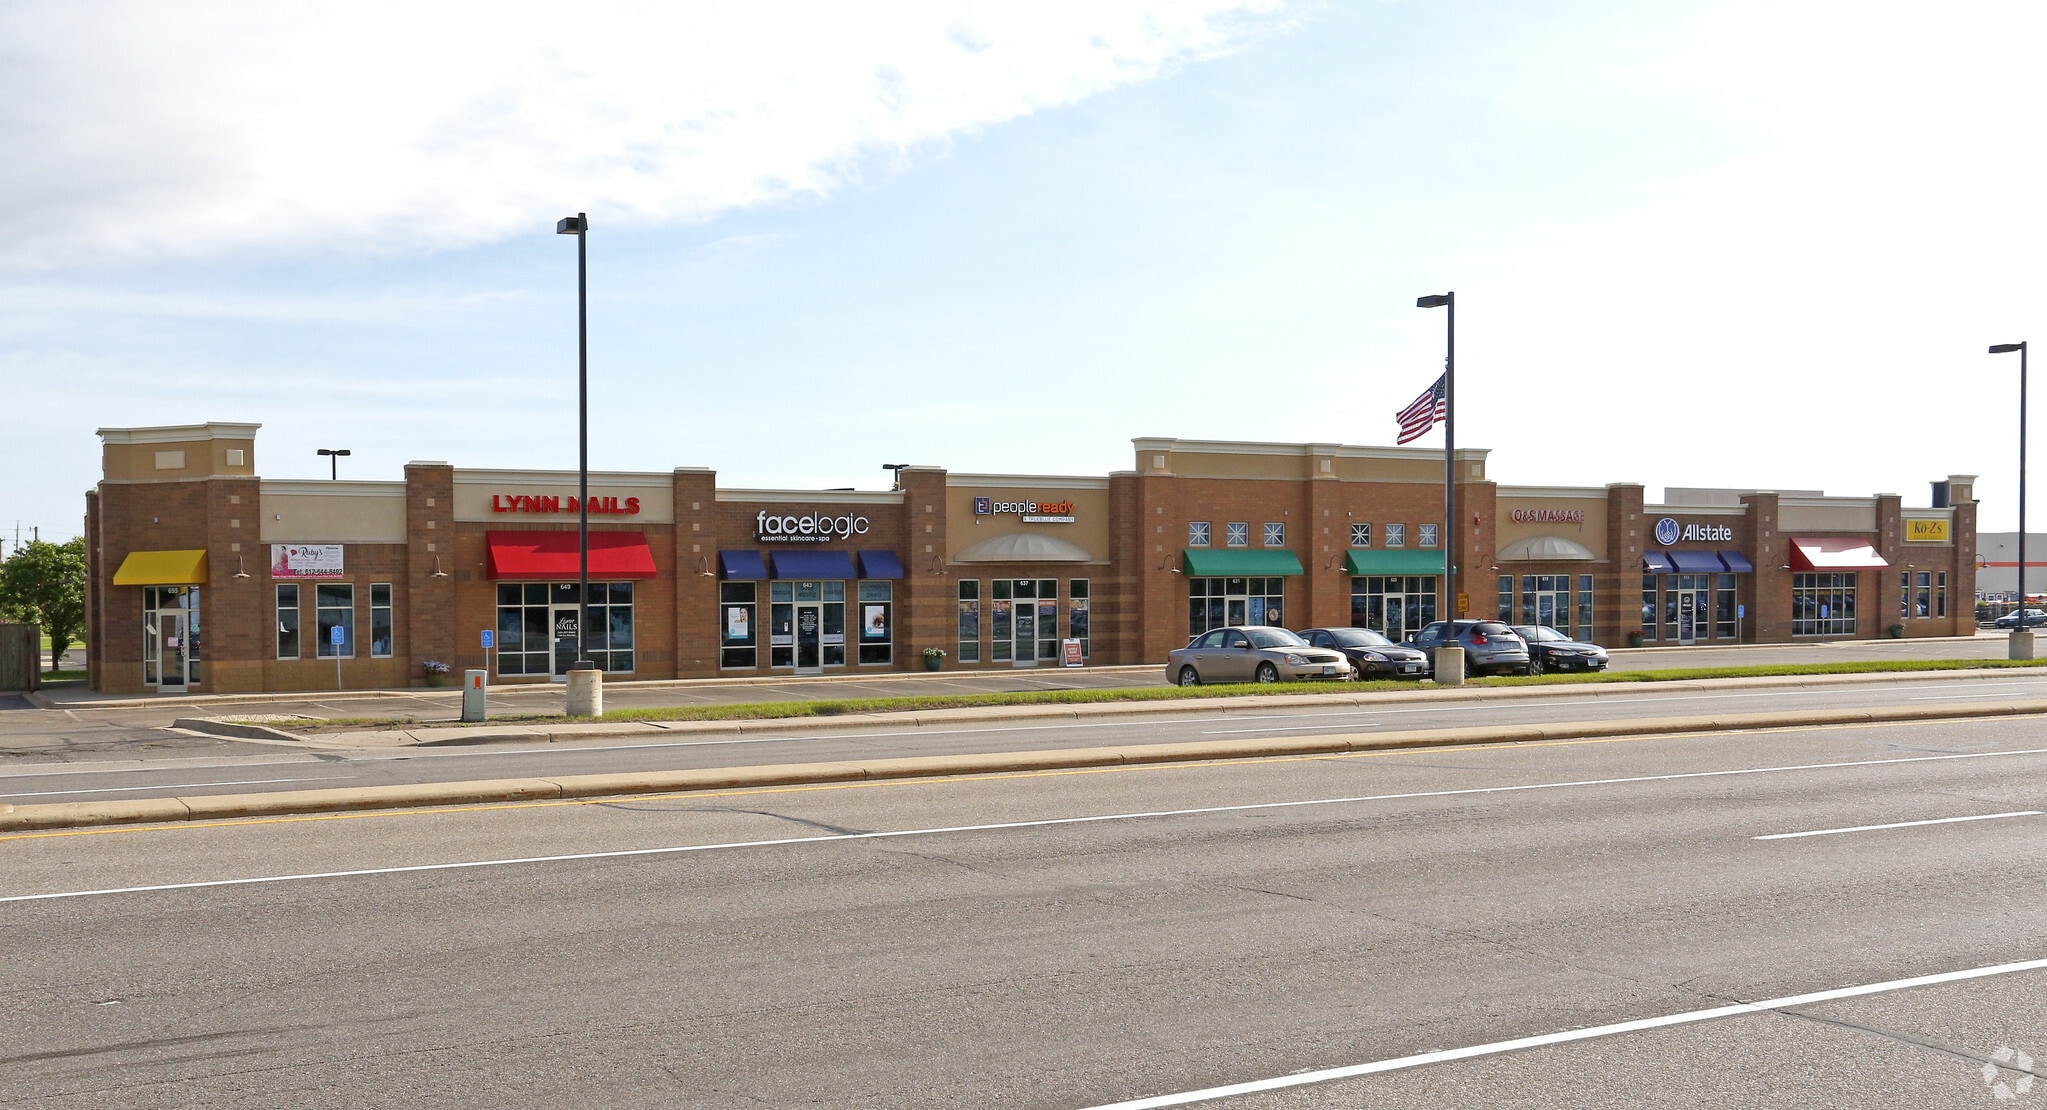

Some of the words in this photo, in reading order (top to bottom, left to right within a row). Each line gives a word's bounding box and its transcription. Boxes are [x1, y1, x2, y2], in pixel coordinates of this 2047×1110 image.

[492, 495, 560, 513] LYNN
[568, 496, 640, 514] NAILS
[993, 500, 1075, 516] peopleready
[1537, 509, 1584, 522] MASSAGE
[757, 510, 869, 540] facelogic
[1682, 524, 1732, 541] Allstate
[298, 546, 323, 560] Ruby's
[556, 623, 578, 631] NAILS
